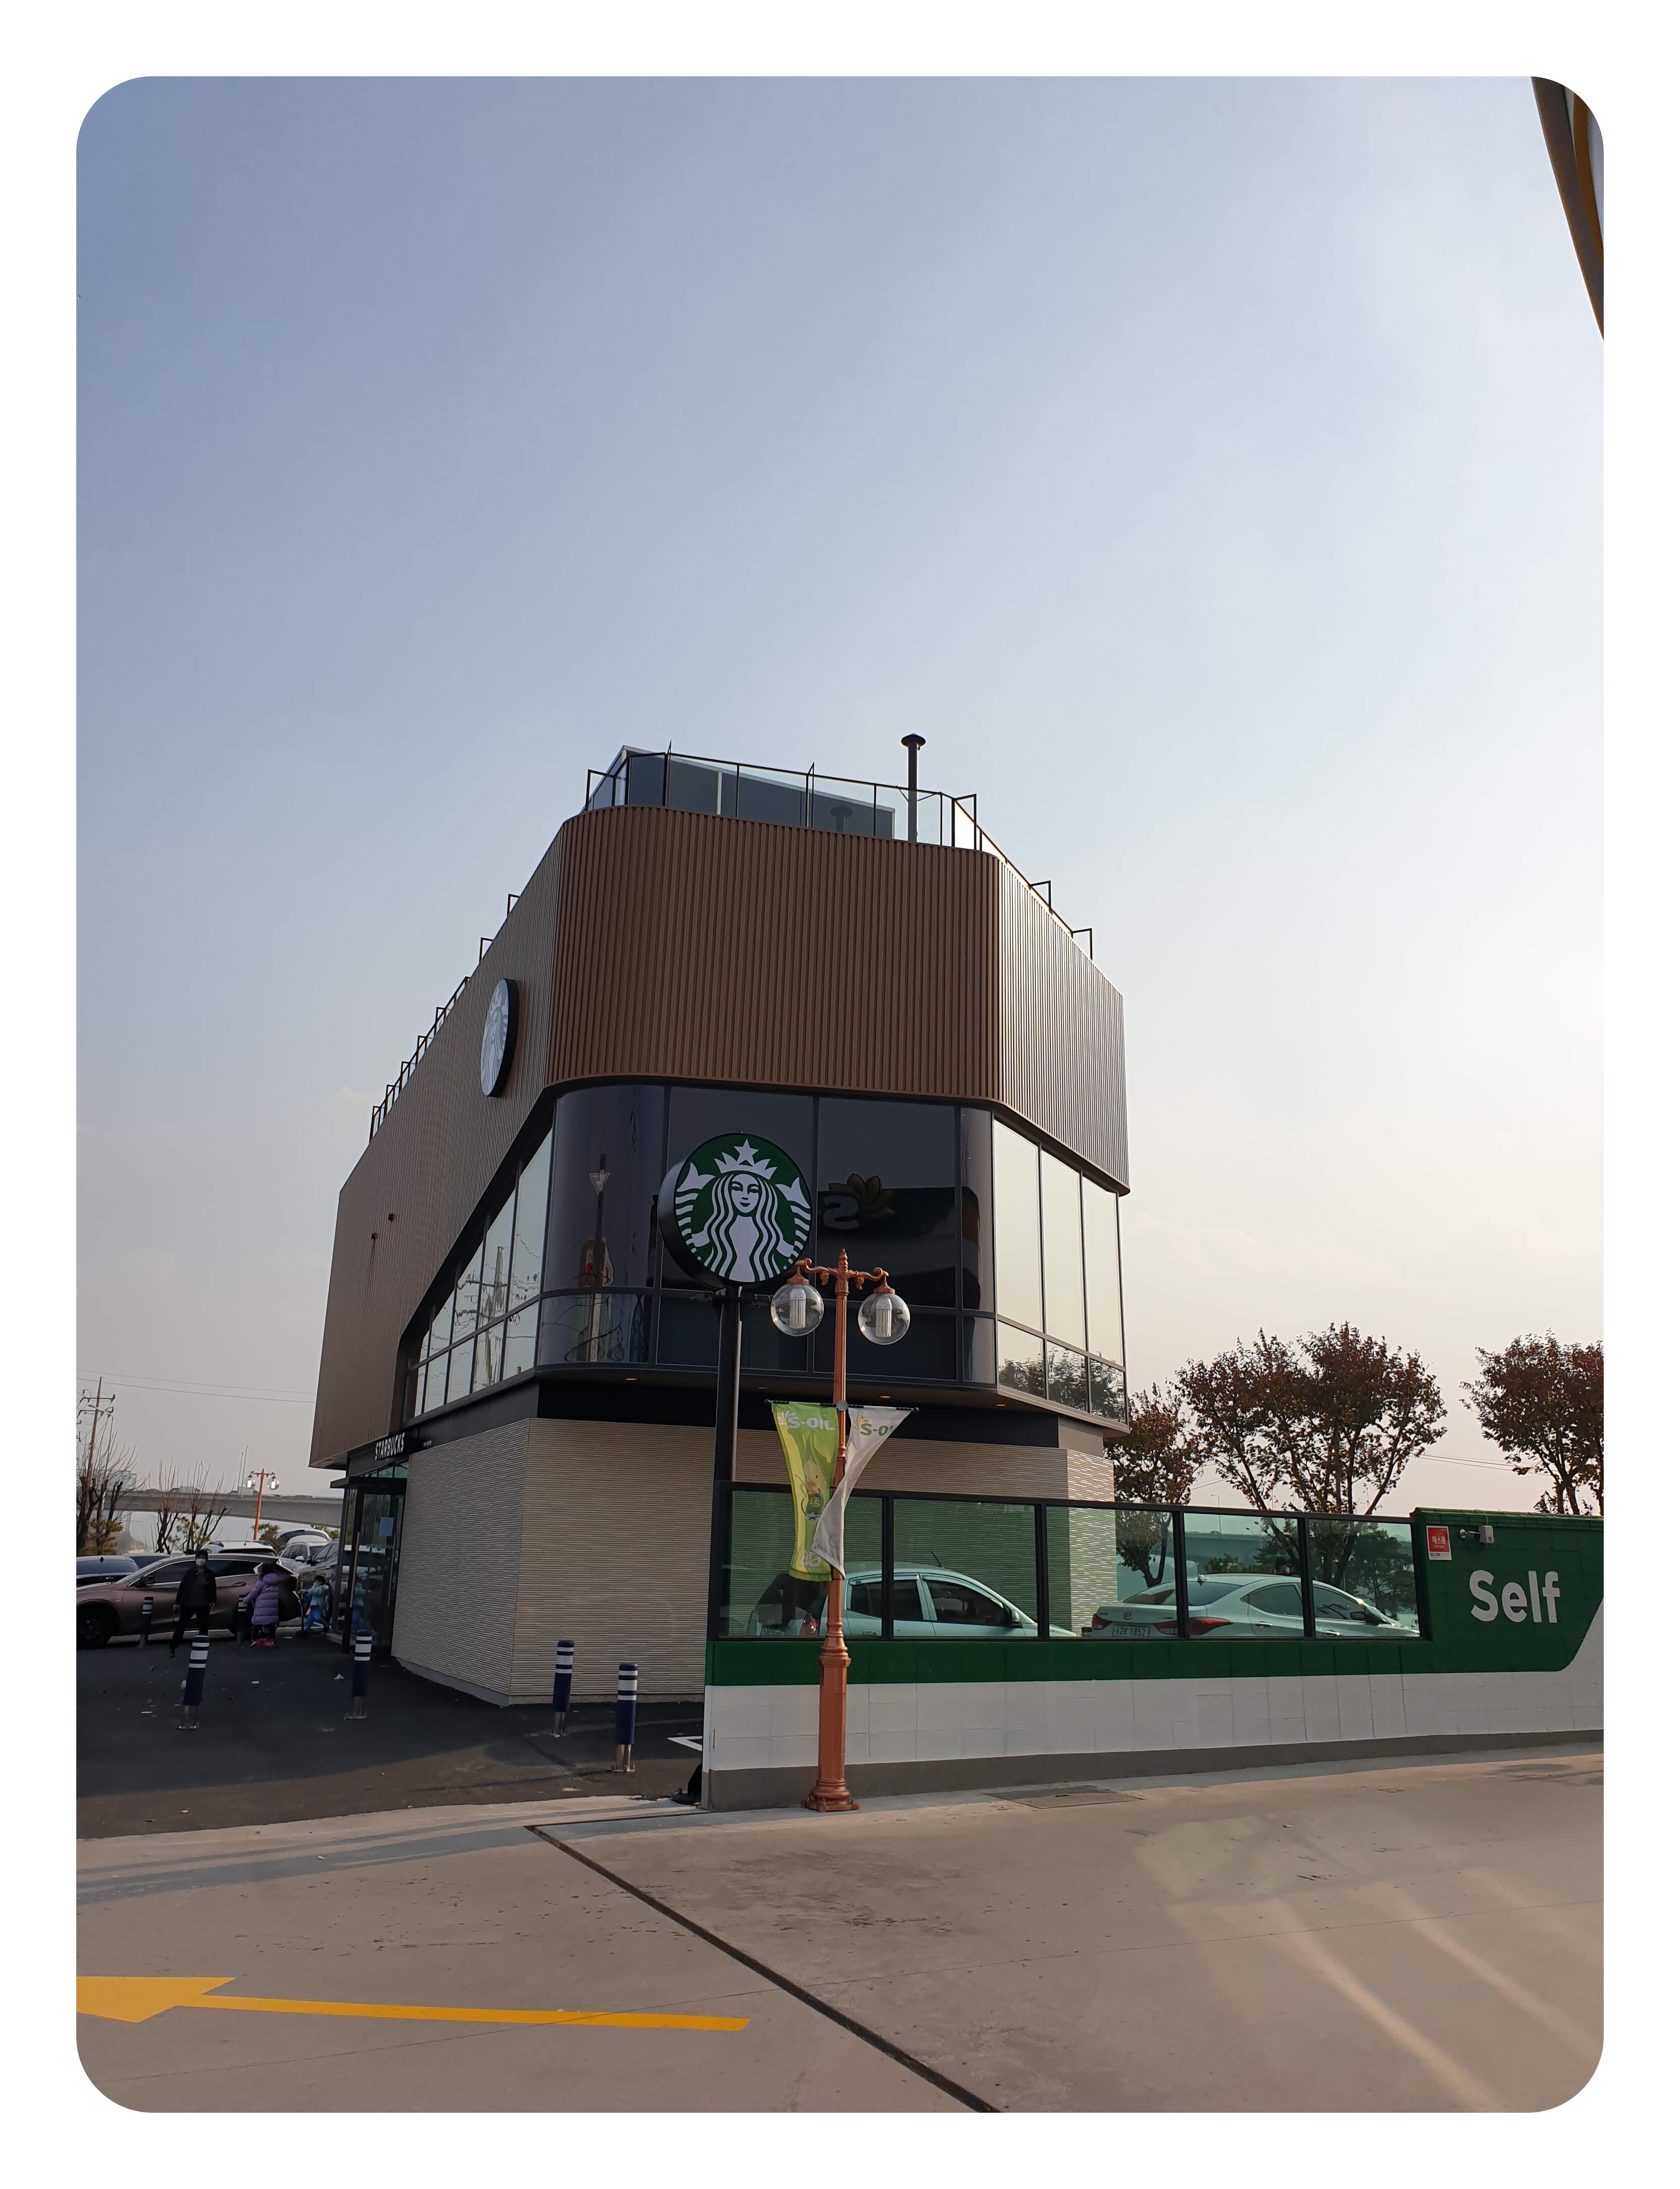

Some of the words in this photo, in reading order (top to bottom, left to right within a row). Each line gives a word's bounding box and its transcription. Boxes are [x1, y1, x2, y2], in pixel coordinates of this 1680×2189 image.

[788, 1416, 836, 1430] S-OIL
[375, 1432, 405, 1461] STARBUCKS
[1469, 1569, 1561, 1623] Self
